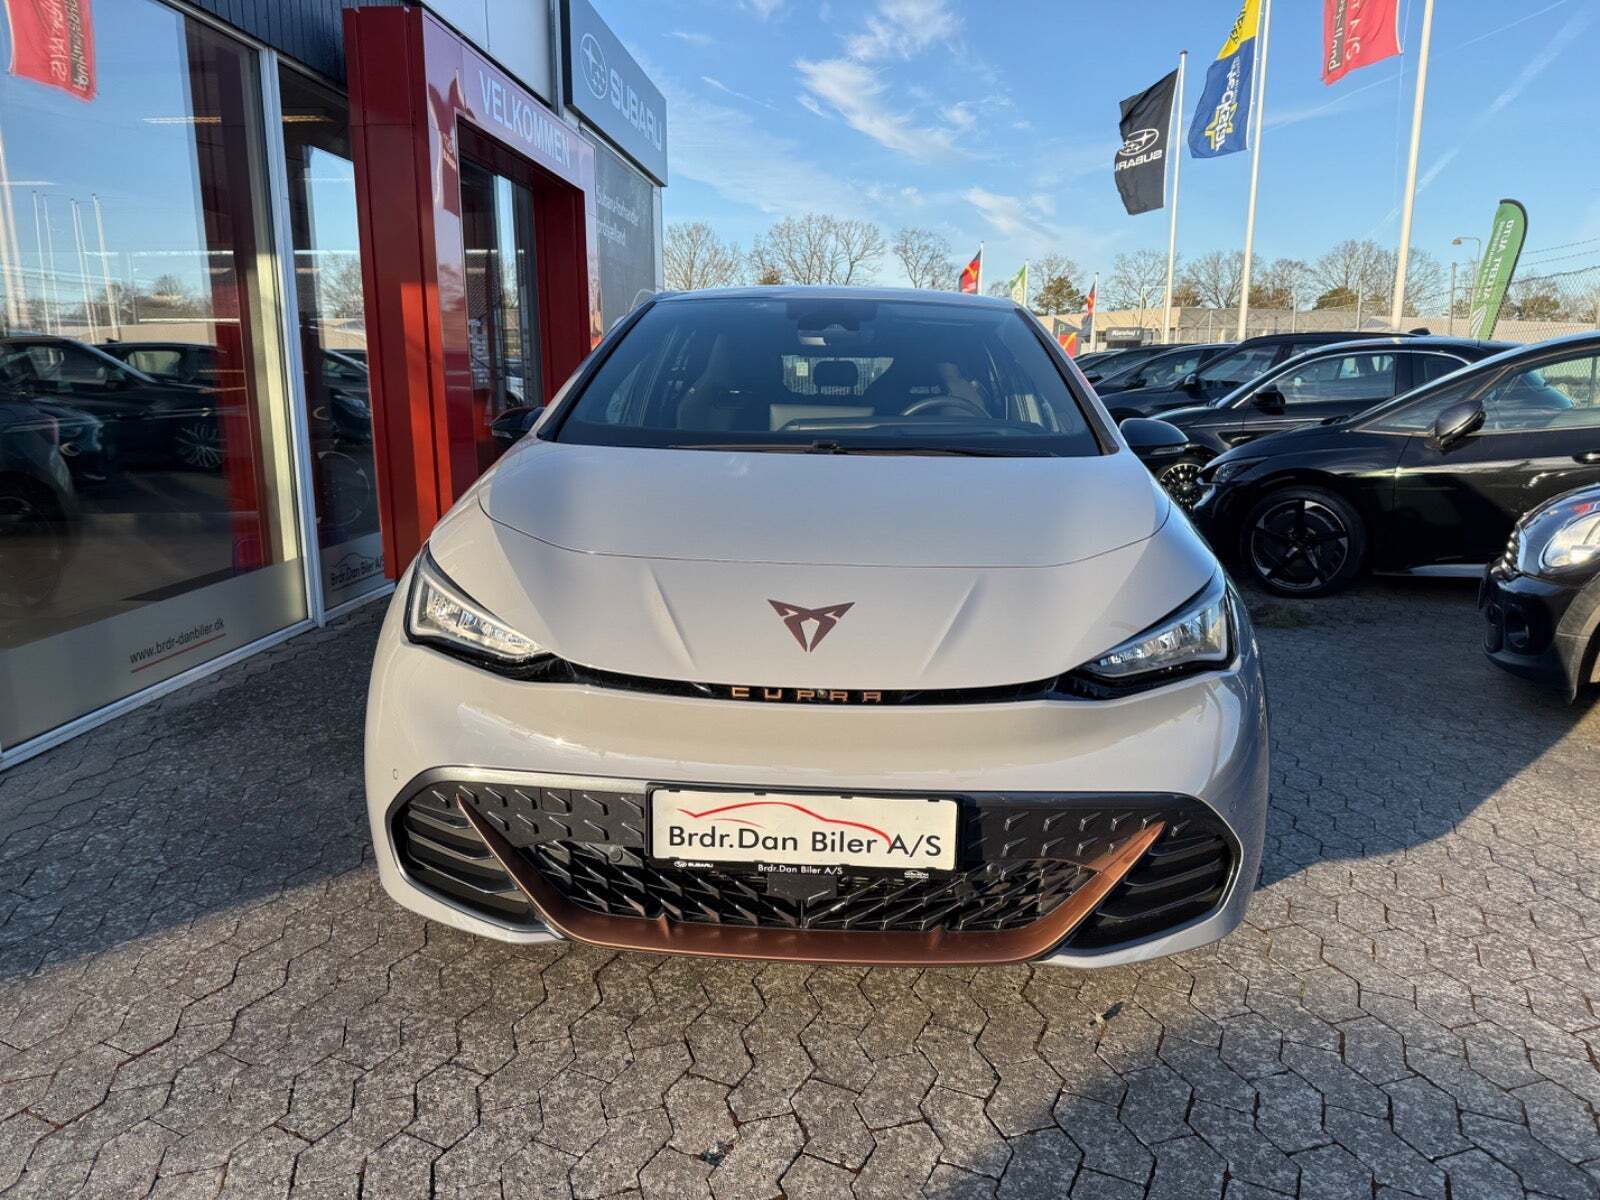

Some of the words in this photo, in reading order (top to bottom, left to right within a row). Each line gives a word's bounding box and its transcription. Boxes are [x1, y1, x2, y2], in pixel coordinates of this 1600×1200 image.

[478, 69, 570, 169] VELKOMMEN
[609, 68, 662, 151] SUBARU
[129, 617, 225, 663] www.brdr-danbiler.dk
[731, 687, 882, 703] CUPRA
[669, 826, 798, 851] Brdr.Dan
[811, 831, 877, 854] Biler
[886, 833, 942, 858] A/S
[757, 864, 798, 873] Brdr.Dan
[800, 866, 821, 874] Biler
[824, 867, 843, 875] A/S
